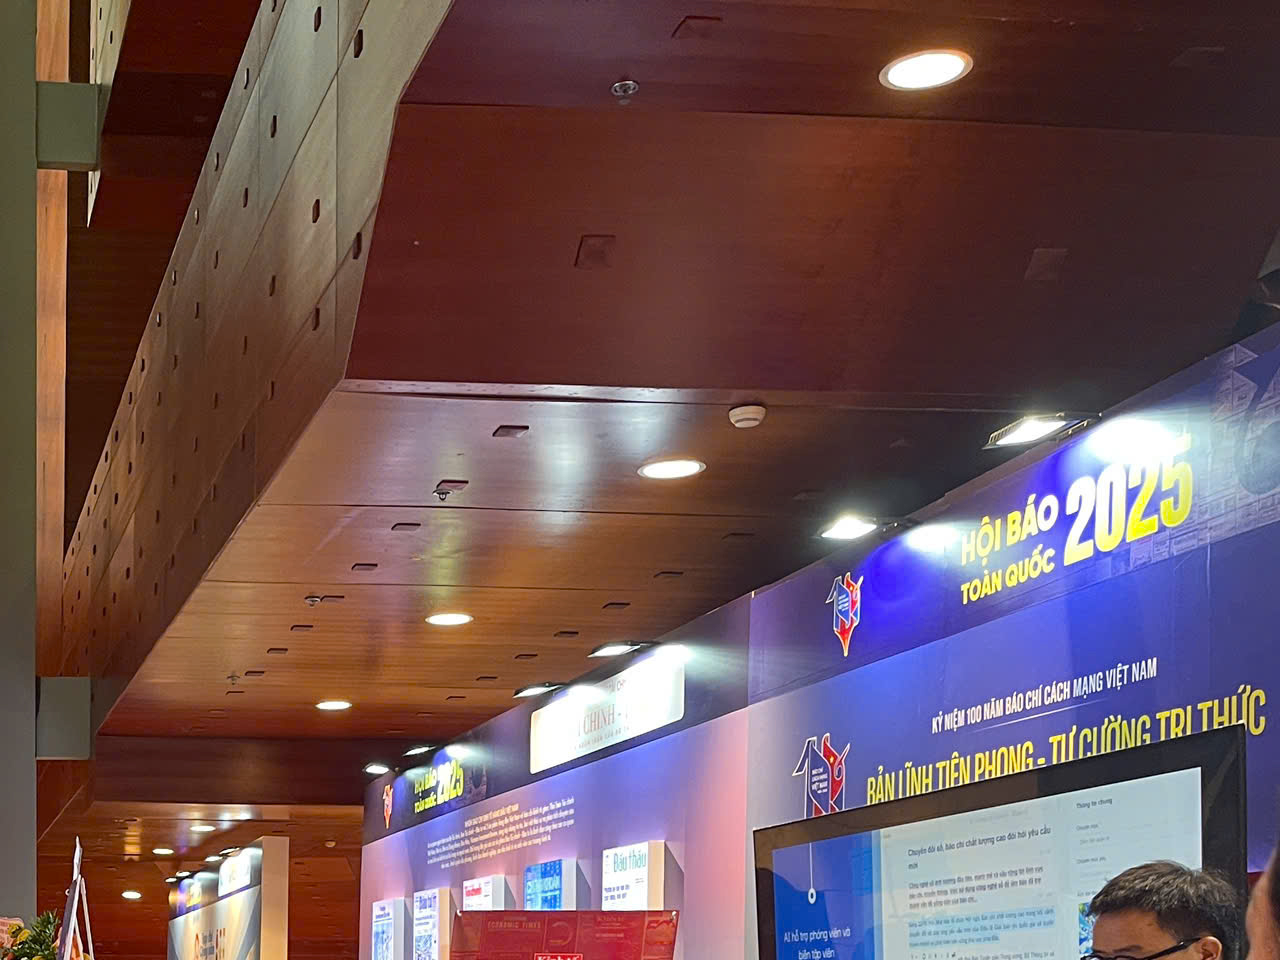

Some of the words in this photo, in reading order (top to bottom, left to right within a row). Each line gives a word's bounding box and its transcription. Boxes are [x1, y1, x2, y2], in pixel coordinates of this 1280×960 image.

[961, 516, 1001, 567] HỘI
[1006, 494, 1059, 547] BÁO
[1064, 436, 1193, 566] 2025
[960, 570, 1003, 605] TOÀN
[1005, 543, 1056, 588] QUỐC
[932, 711, 943, 734] KỶ
[944, 708, 965, 731] NIỆM
[967, 704, 982, 724] 100
[983, 697, 1004, 720] NĂM
[1005, 691, 1024, 715] BÁO
[1025, 684, 1043, 710] CHÍ
[1044, 681, 1071, 706] CÁCH
[1073, 671, 1103, 699] MẠNG
[1105, 663, 1129, 690] VIỆT
[1131, 657, 1157, 682] NAM
[867, 765, 895, 805] BẢN
[974, 741, 1034, 782] PHONG
[1156, 705, 1192, 741] TRI
[1197, 684, 1266, 736] THỨC
[996, 834, 1007, 842] cao
[809, 929, 828, 943] phóng
